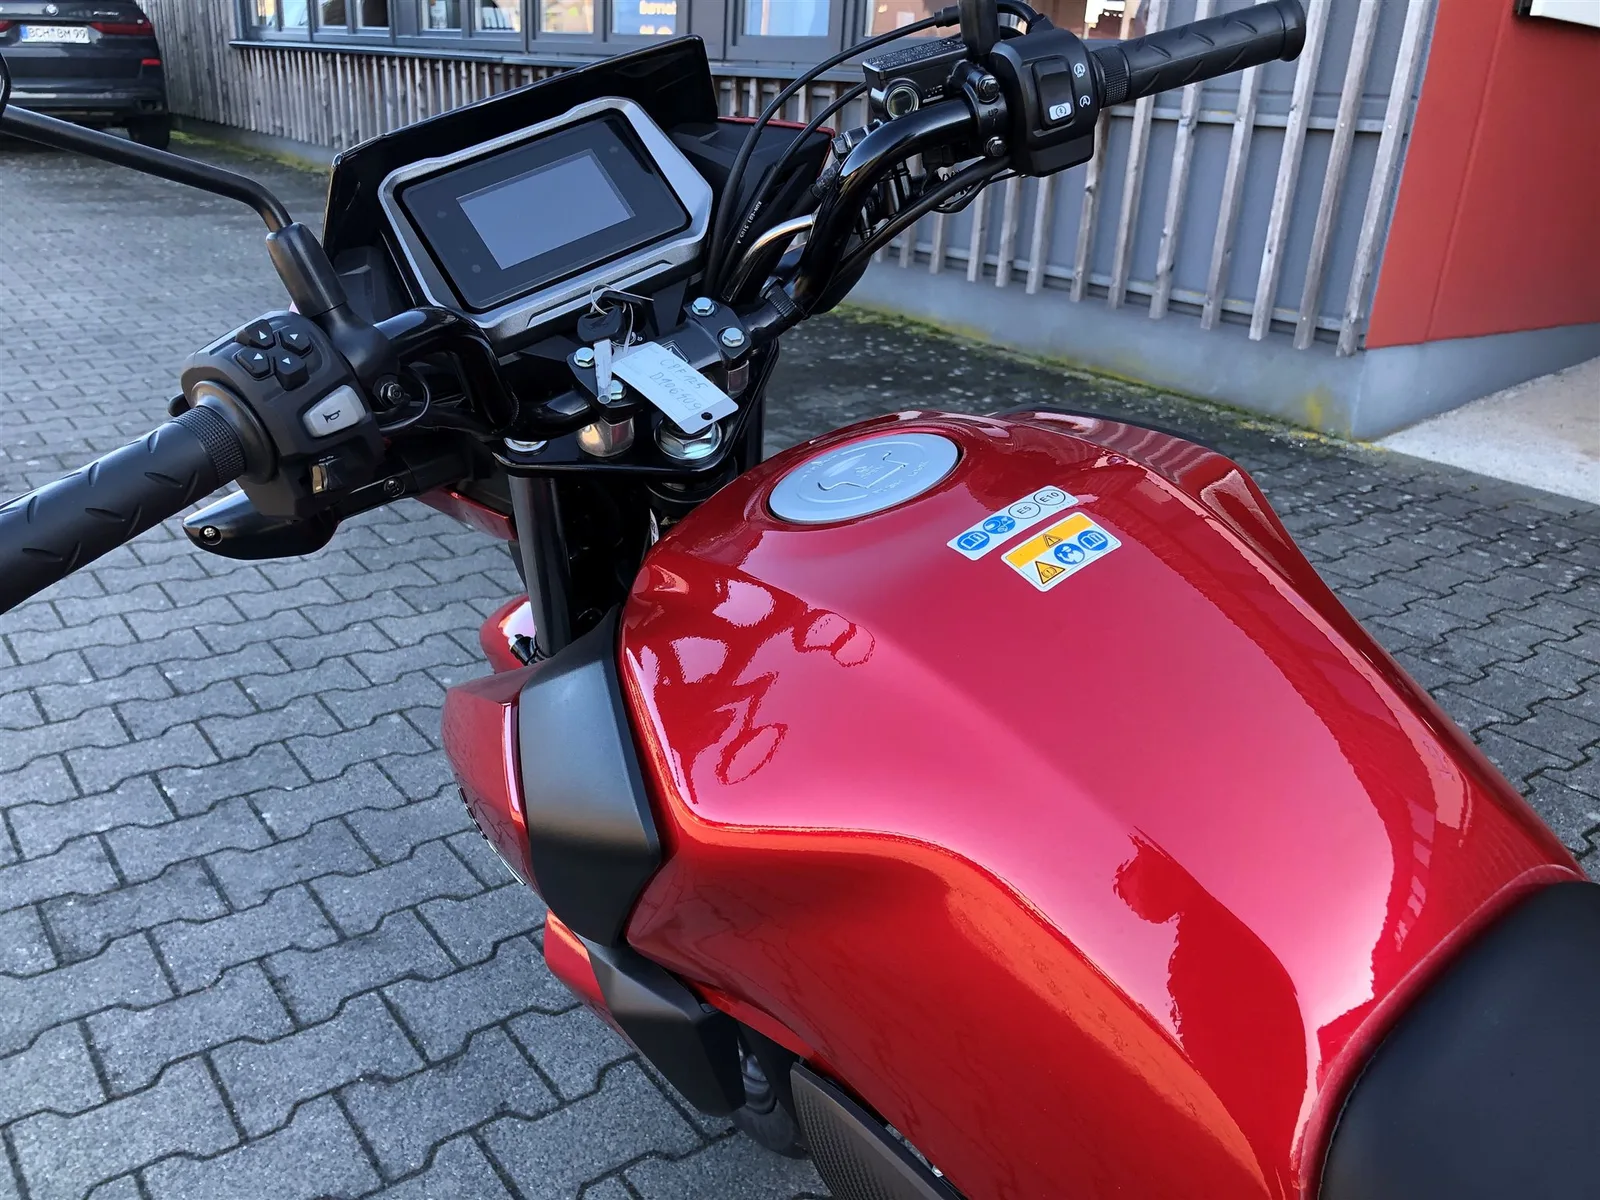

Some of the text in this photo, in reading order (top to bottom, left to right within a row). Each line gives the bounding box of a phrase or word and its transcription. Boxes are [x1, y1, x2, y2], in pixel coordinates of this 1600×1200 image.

[29, 27, 86, 39] BCH BM 99
[1039, 491, 1059, 503] E10
[1016, 505, 1032, 515] E5
